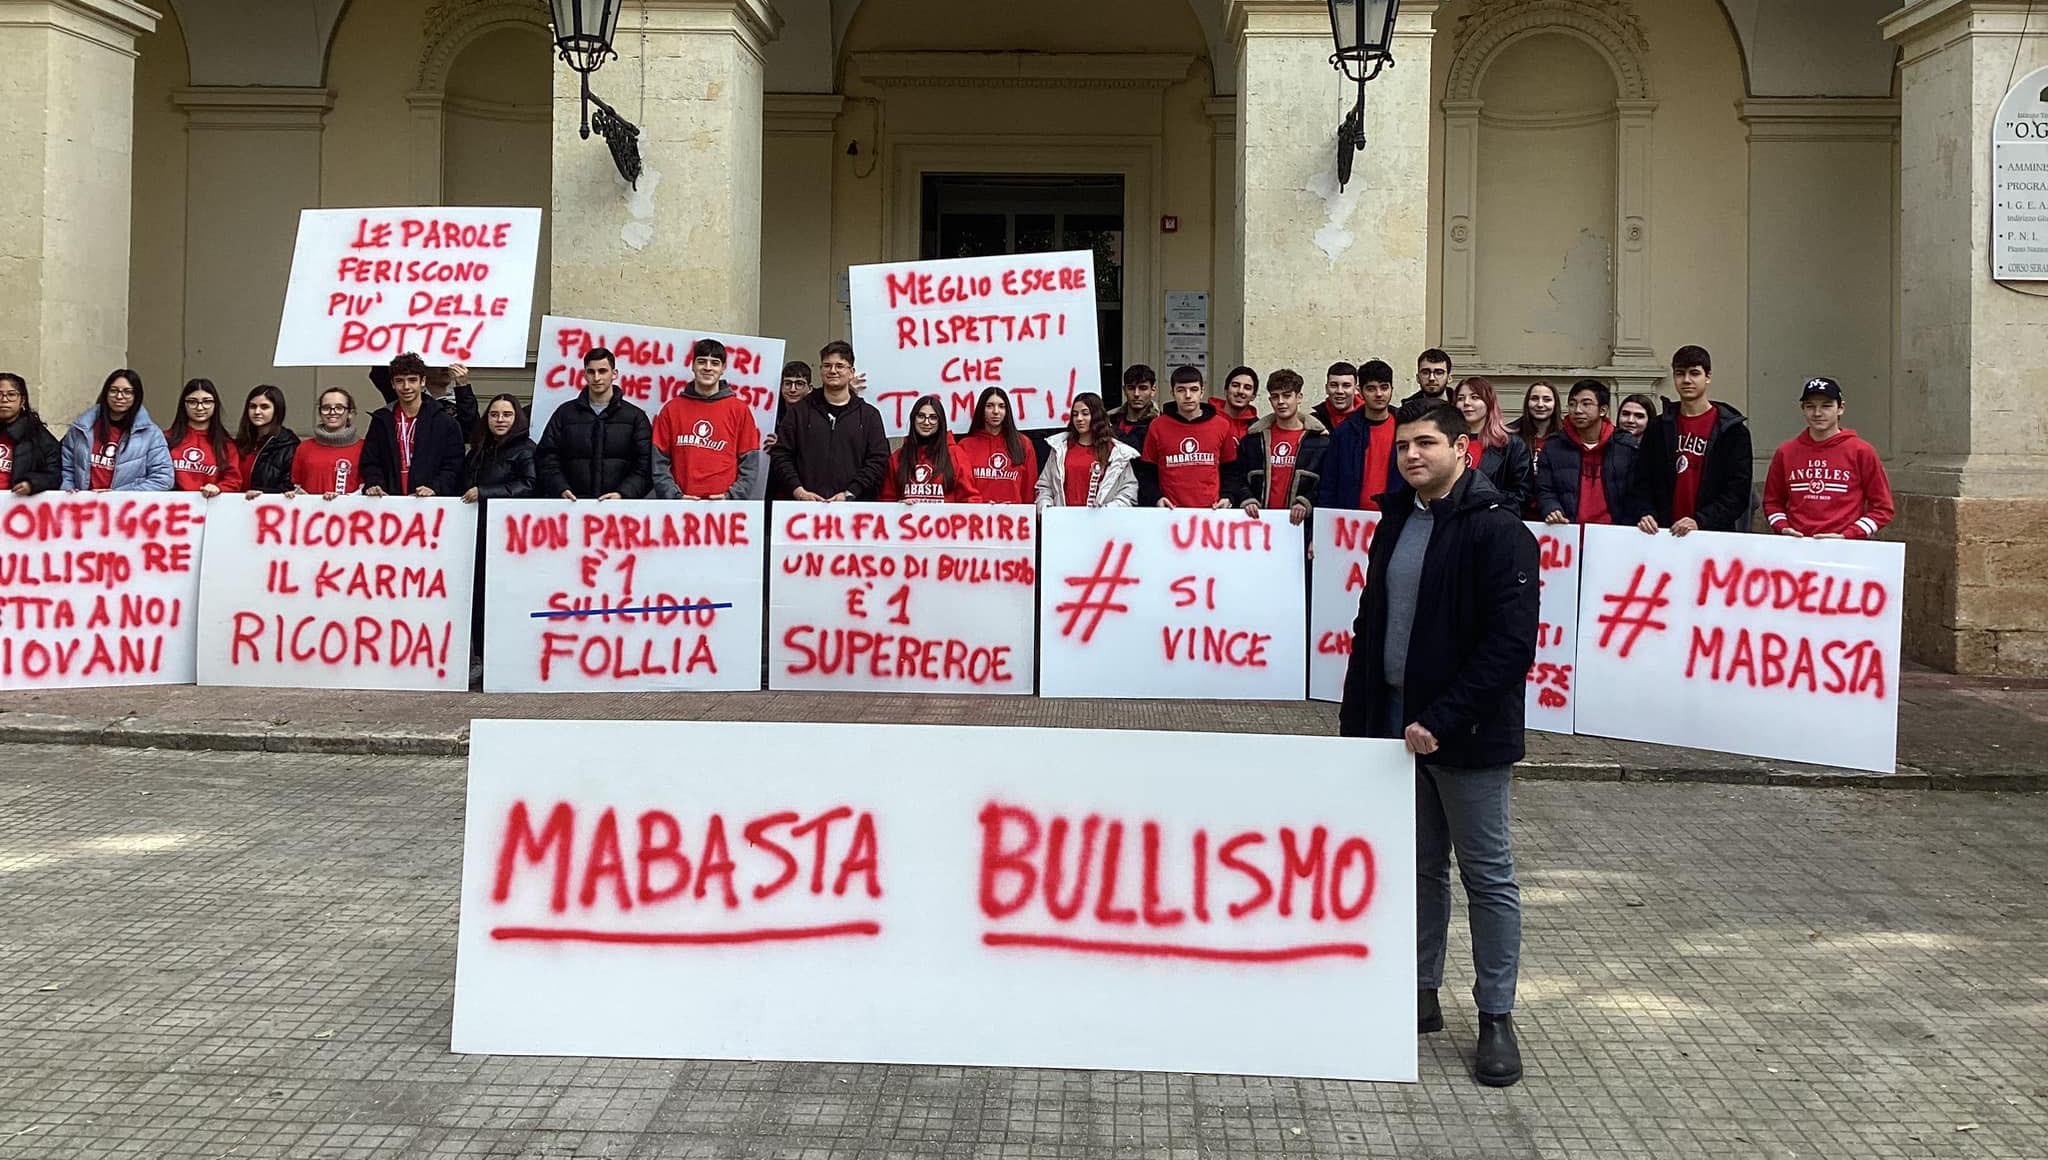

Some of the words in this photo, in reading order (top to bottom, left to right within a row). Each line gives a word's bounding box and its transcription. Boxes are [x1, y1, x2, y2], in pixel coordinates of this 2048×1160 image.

[2007, 182, 2048, 190] PROGRA
[351, 218, 391, 250] LE
[400, 219, 510, 249] PAROLE
[337, 256, 489, 284] FERISCONO
[886, 271, 992, 309] MEGLIO
[1001, 267, 1085, 296] ESSERE
[408, 291, 508, 317] DELLE
[338, 320, 484, 361] BOTTE!
[897, 313, 1065, 349] RISPETTATI
[612, 336, 674, 367] AGLI
[941, 356, 1003, 384] CHE
[876, 368, 1077, 429] TMTI!
[1808, 379, 1829, 389] NY
[1789, 468, 1851, 481] ANGELES
[1808, 459, 1828, 468] LOS
[255, 504, 445, 550] RICORDA!
[506, 513, 569, 556] NON
[582, 512, 749, 554] PARLARNE
[785, 513, 844, 541] CHI
[851, 513, 889, 540] FA
[898, 513, 1030, 541] SCOPRIRE
[1171, 516, 1271, 550] UNITI
[140, 539, 191, 574] RE
[617, 553, 637, 596] 1
[783, 552, 825, 577] UN
[830, 553, 897, 578] CASO
[903, 554, 929, 580] DI
[936, 554, 1036, 586] BULLISMO
[267, 560, 299, 595] IL
[314, 562, 447, 600] KARMA
[1056, 541, 1139, 644] #
[1170, 576, 1214, 610] SI
[1696, 558, 1887, 618] MODELLO
[0, 595, 76, 630] TTA
[87, 595, 111, 630] A
[119, 594, 181, 630] NOI
[548, 589, 716, 629] SUICIDIO
[888, 584, 911, 626] 1
[1598, 564, 1672, 659] #
[231, 611, 452, 679] RICORDA!
[540, 631, 717, 681] FOLLIA
[783, 624, 1011, 685] SUPEREROE
[1163, 626, 1270, 668] VINCE
[1685, 626, 1885, 700] MABASTA
[491, 800, 882, 916] MABASTA
[978, 801, 1376, 929] BULLISMO
